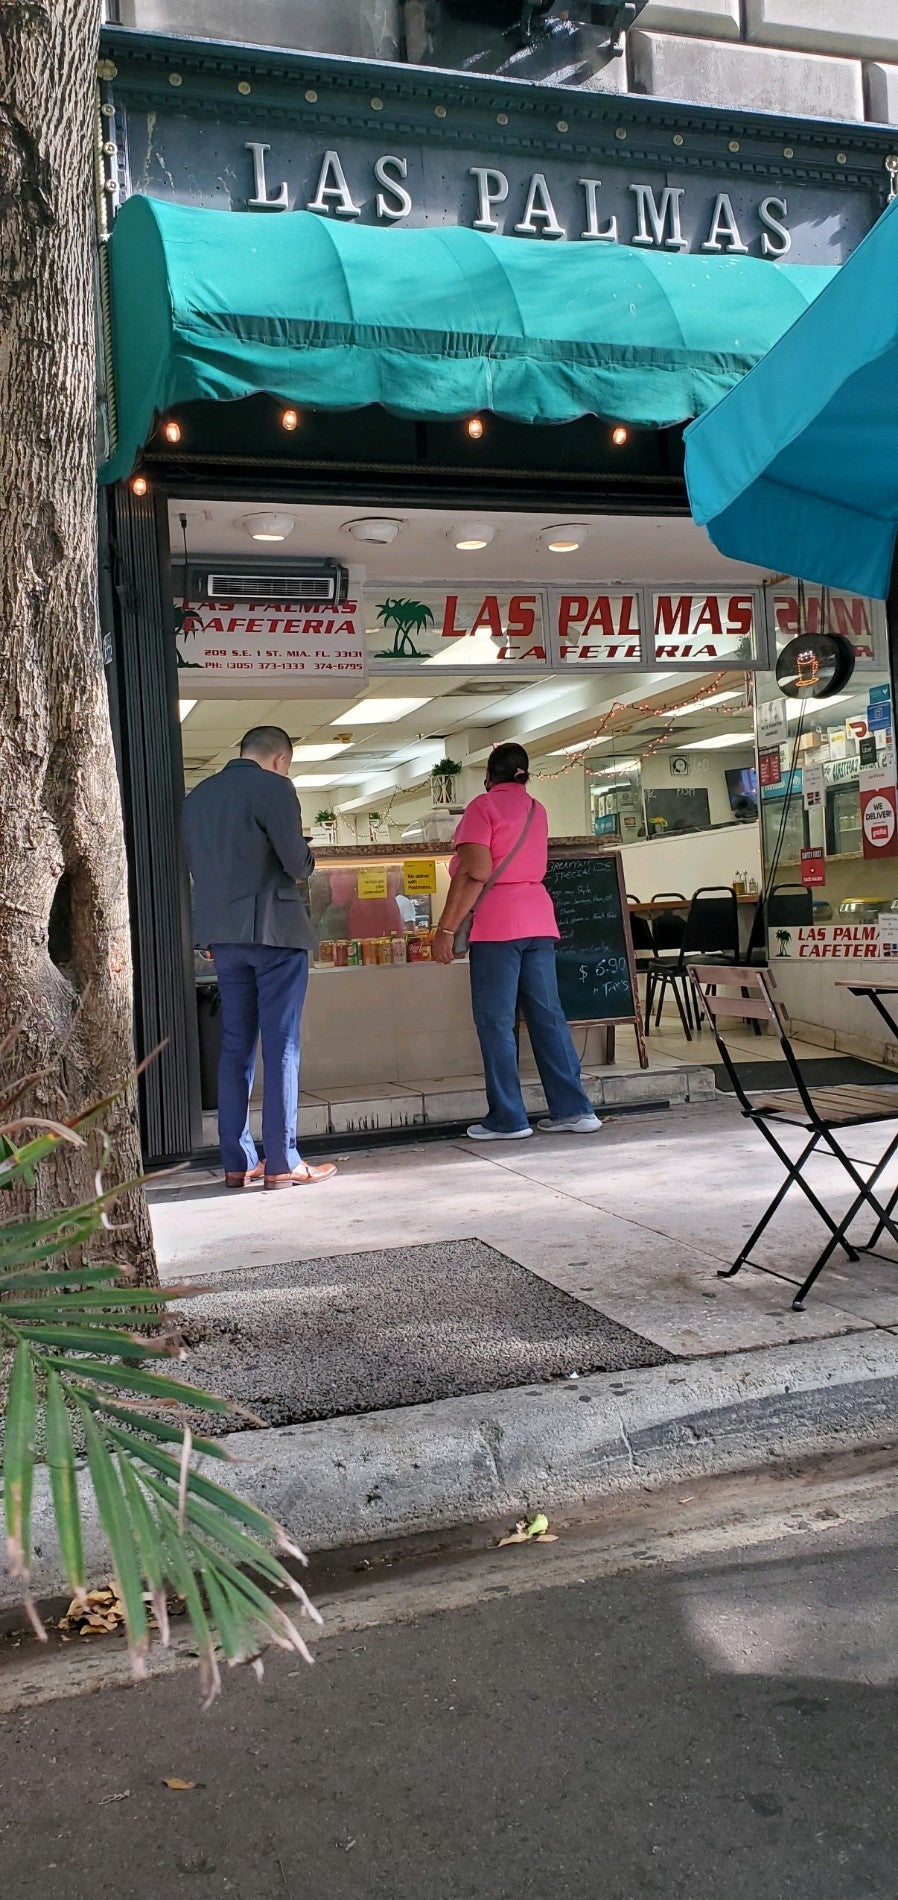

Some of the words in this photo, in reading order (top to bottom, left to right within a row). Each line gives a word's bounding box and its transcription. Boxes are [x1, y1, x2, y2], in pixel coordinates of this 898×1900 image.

[245, 142, 412, 219] LAS
[469, 166, 792, 256] PALMAS
[441, 595, 536, 637] LAS
[557, 595, 753, 636] PALMAS
[182, 616, 356, 635] CAFETERIA
[204, 649, 227, 657] 209
[286, 650, 310, 658] MIA.
[315, 650, 330, 658] FL.
[334, 650, 362, 658] 33131
[496, 644, 719, 660] CAFETERIA
[226, 662, 253, 670] (305)
[258, 662, 305, 670] 373-1333
[873, 802, 883, 811] WE
[798, 928, 826, 941] LAS
[833, 927, 880, 941] PALM
[799, 944, 880, 958] CAFETER
